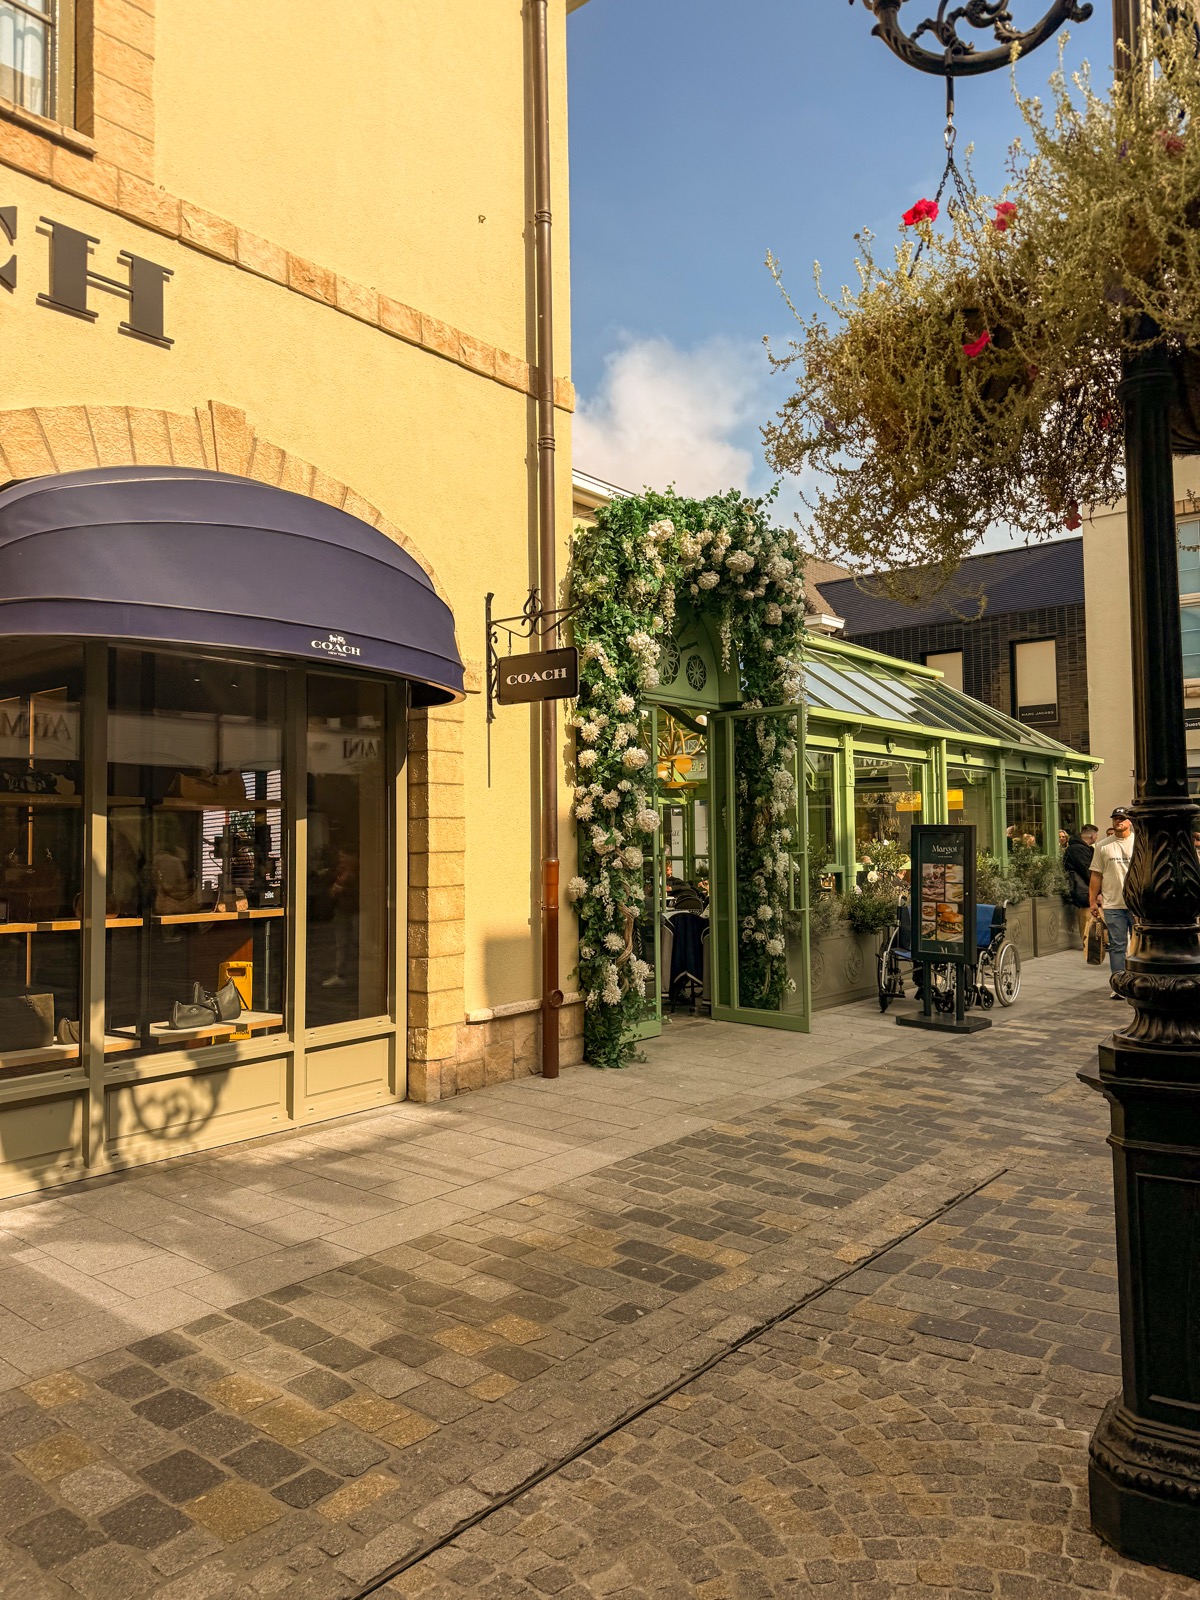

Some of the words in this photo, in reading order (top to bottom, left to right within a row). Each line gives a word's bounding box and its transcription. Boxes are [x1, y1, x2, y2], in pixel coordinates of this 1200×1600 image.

[0, 206, 174, 345] H
[311, 640, 361, 656] COACH
[506, 667, 567, 685] COACH
[932, 845, 957, 855] Margot
